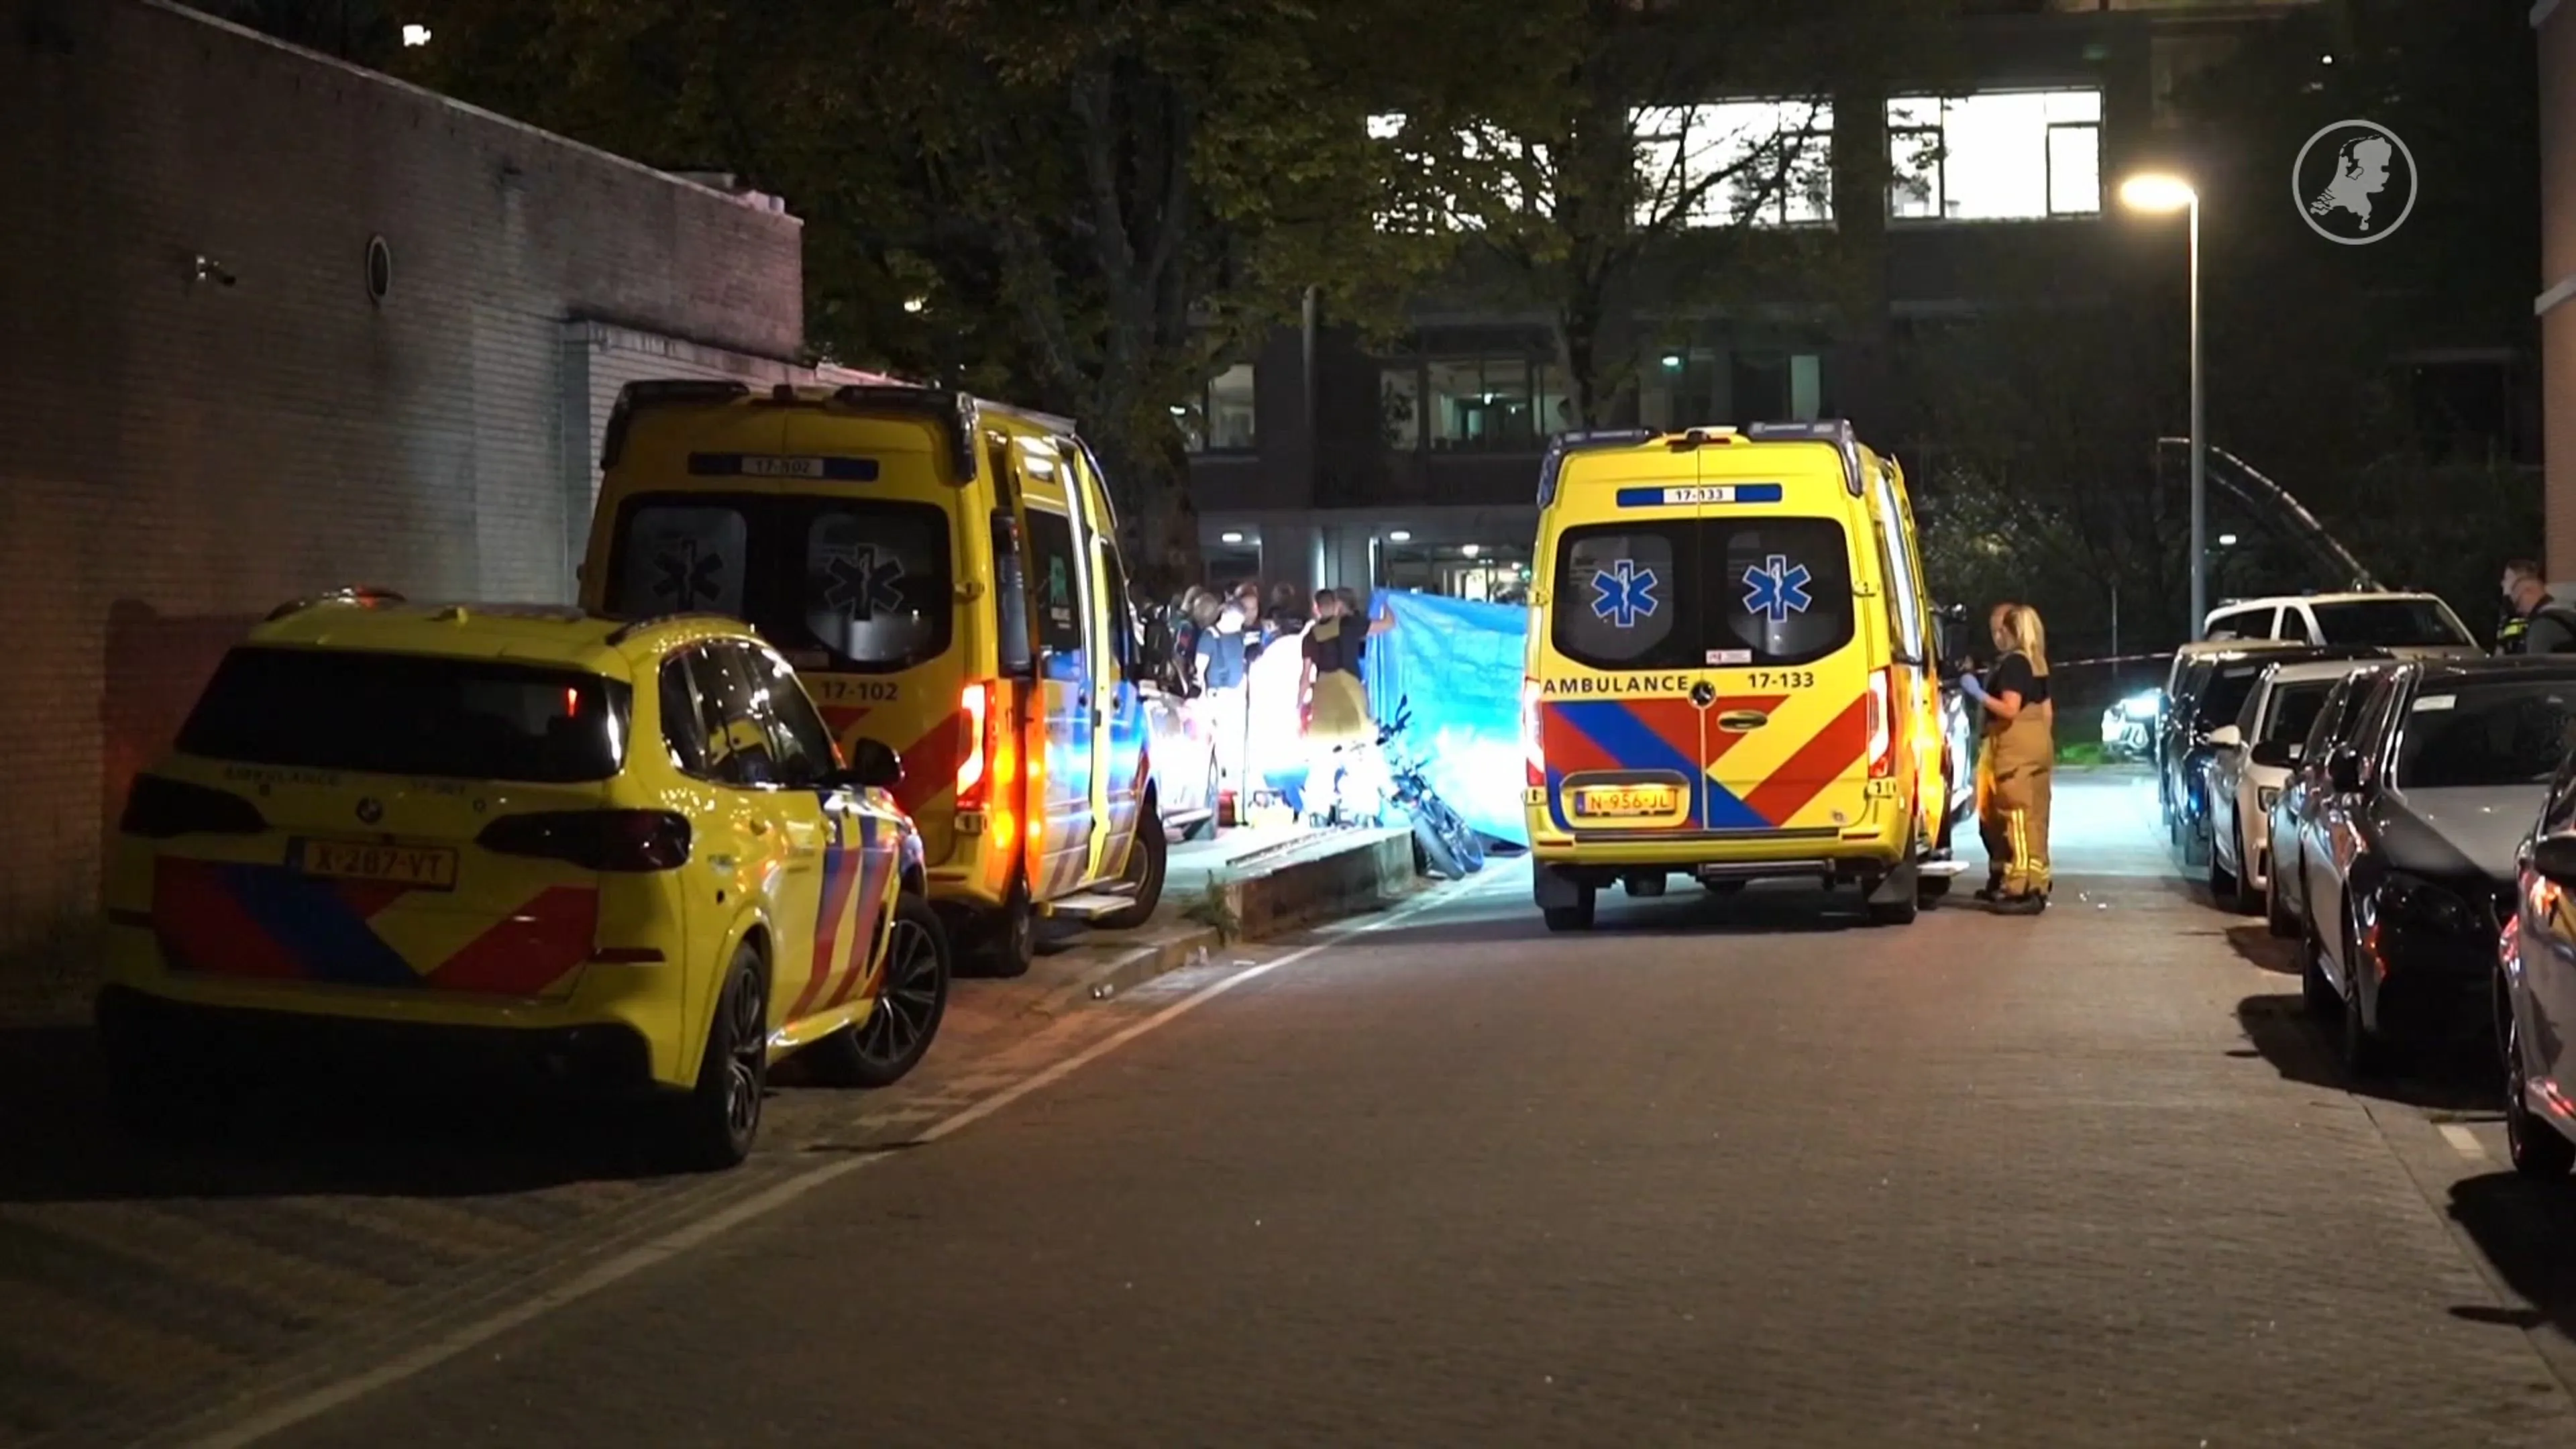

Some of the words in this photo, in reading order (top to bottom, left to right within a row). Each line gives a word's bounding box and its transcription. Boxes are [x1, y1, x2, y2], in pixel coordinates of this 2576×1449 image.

[1676, 488, 1723, 500] 17-133
[821, 680, 899, 701] 17-102
[1543, 675, 1689, 694] AMBULANCE
[1748, 672, 1814, 688] 17-133
[1591, 793, 1668, 810] N-956-JL
